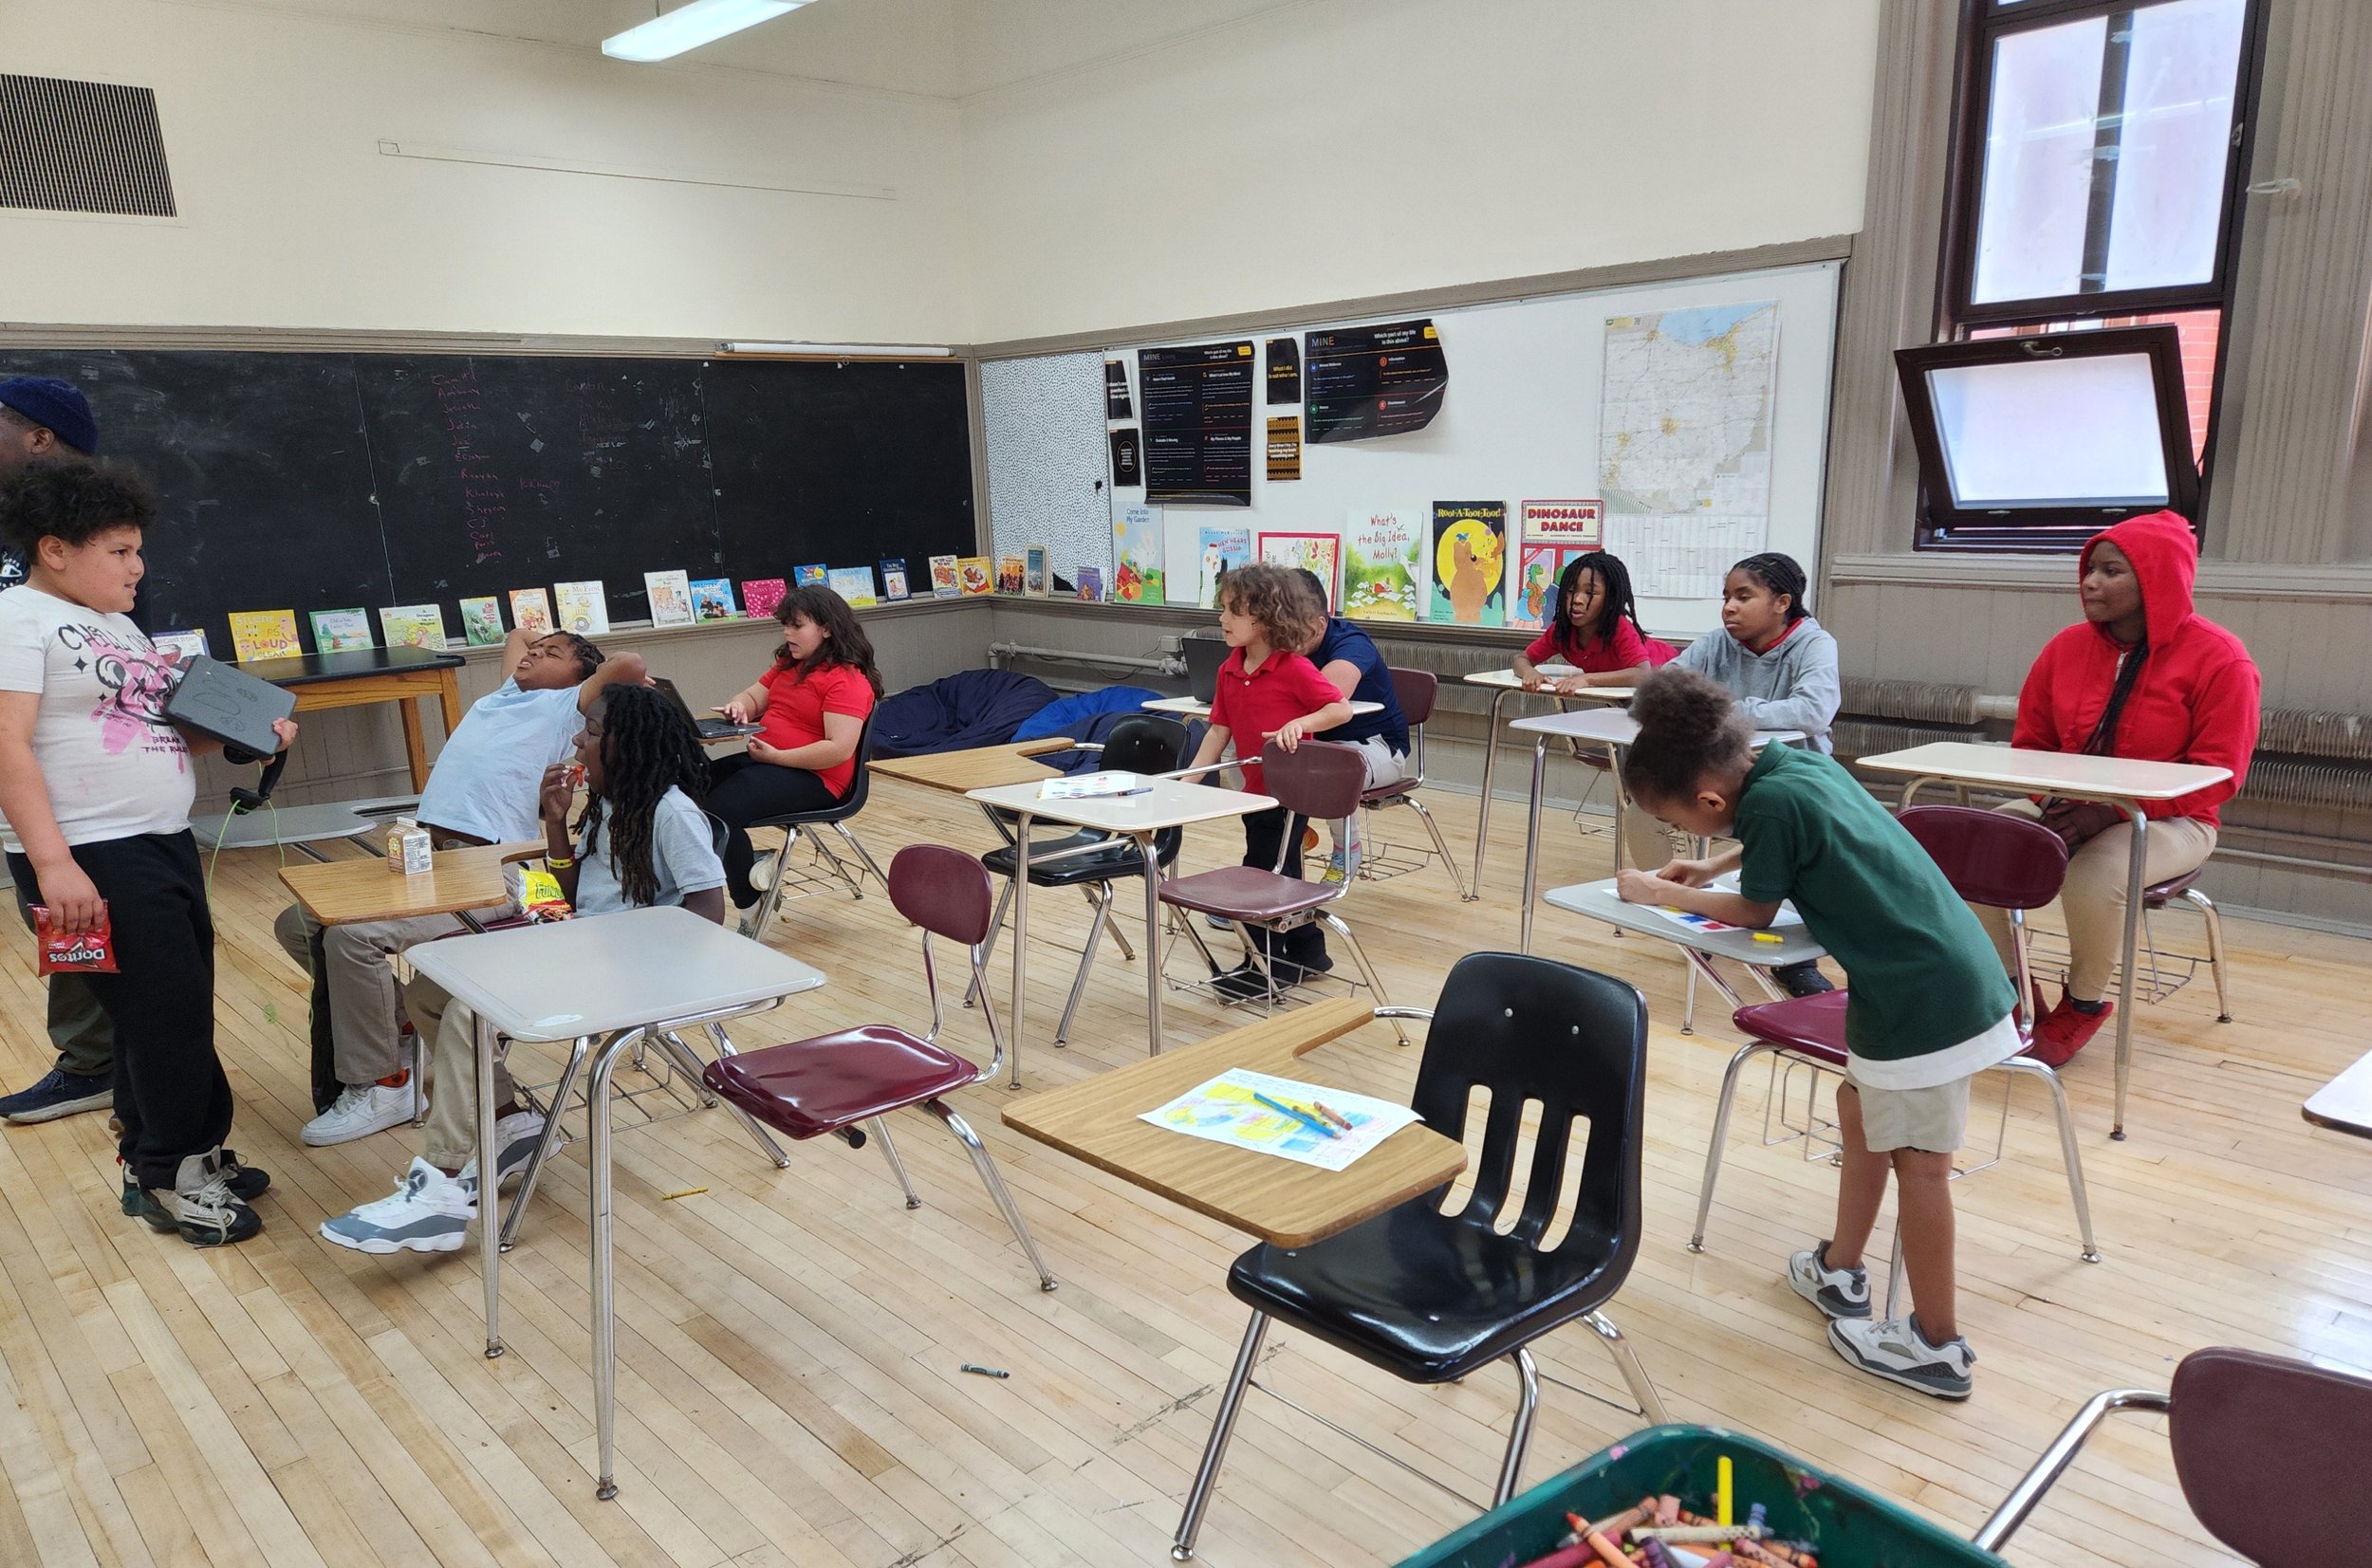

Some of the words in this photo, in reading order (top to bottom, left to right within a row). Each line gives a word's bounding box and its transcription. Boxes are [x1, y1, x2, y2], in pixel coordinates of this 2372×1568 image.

[1311, 336, 1335, 347] MINE
[1528, 508, 1596, 519] DINOSAUR
[1126, 515, 1133, 524] My
[1370, 513, 1397, 526] What's
[1541, 521, 1584, 532] DANCE
[1358, 533, 1372, 546] the
[1374, 531, 1386, 547] Big
[1387, 530, 1410, 543] Idea,
[1373, 547, 1398, 562] Molly?
[252, 639, 288, 650] LOUD
[152, 733, 181, 745] BREAK
[169, 746, 189, 754] RULE
[49, 949, 105, 963] Doritos
